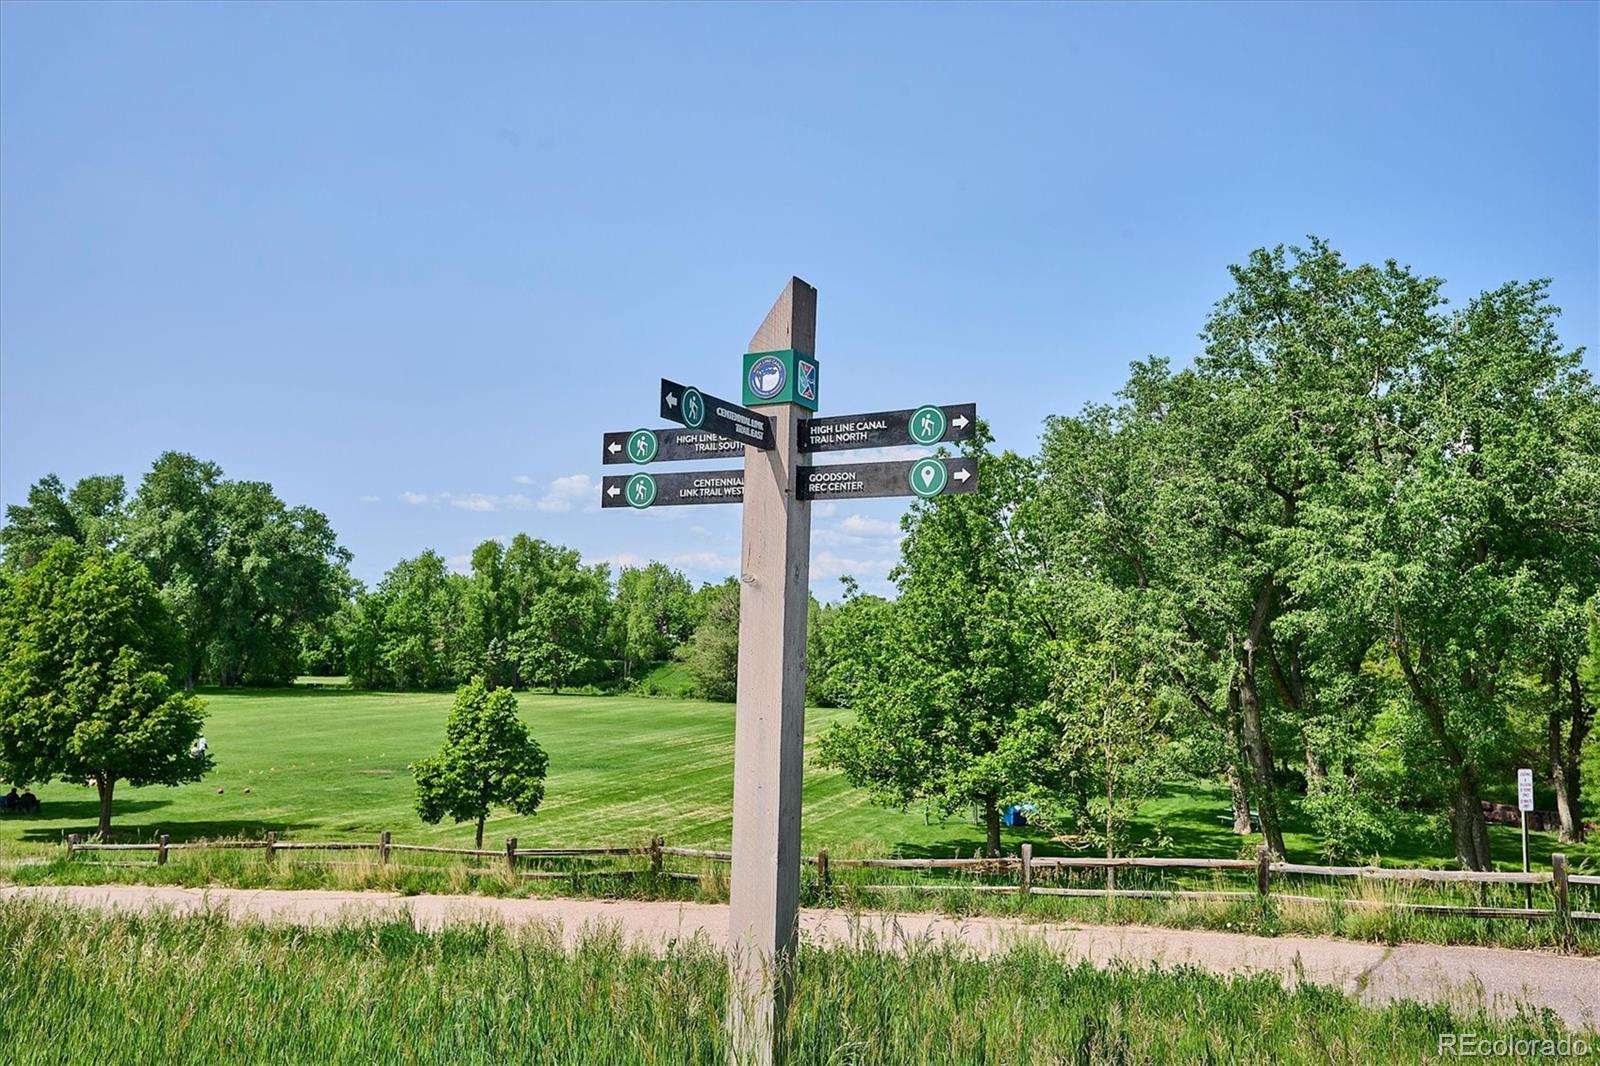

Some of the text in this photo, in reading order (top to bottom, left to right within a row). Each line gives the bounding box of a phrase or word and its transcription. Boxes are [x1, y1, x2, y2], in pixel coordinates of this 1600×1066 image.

[810, 420, 887, 434] HIGH LINE CANAL
[676, 434, 698, 444] HIGH
[699, 433, 718, 442] LINE
[809, 432, 868, 444] TRAIL NORTH
[694, 442, 717, 452] TRAIL
[809, 472, 856, 482] GOODSON
[693, 478, 745, 488] CENTENNIAL
[808, 481, 864, 492] REC CENTER
[679, 486, 745, 498] LINK TRAIL WEST
